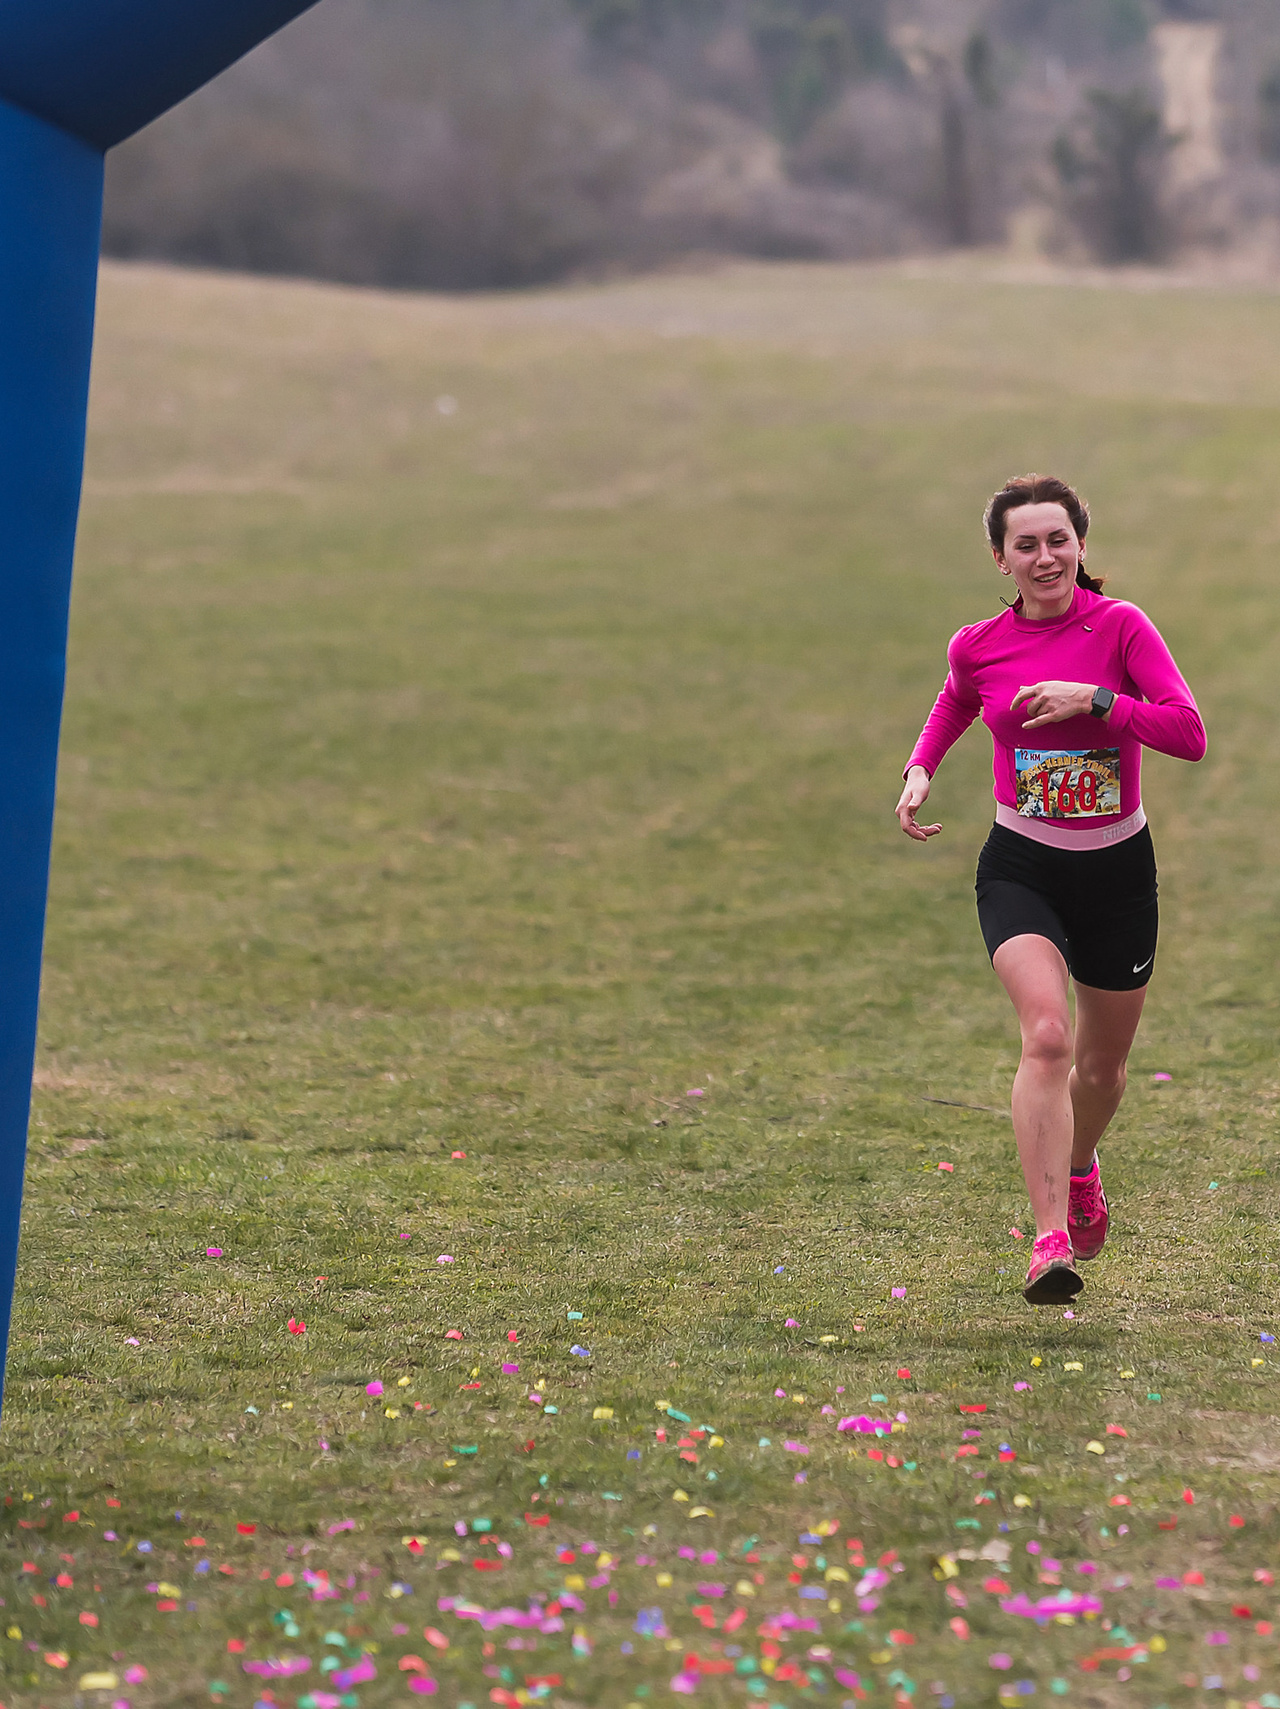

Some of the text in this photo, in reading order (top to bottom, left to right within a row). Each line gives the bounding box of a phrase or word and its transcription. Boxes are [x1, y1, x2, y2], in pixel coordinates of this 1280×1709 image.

[1020, 750, 1028, 760] 12
[1086, 760, 1112, 779] TRAIL
[1037, 770, 1097, 813] 168
[1103, 820, 1131, 841] NIKE
